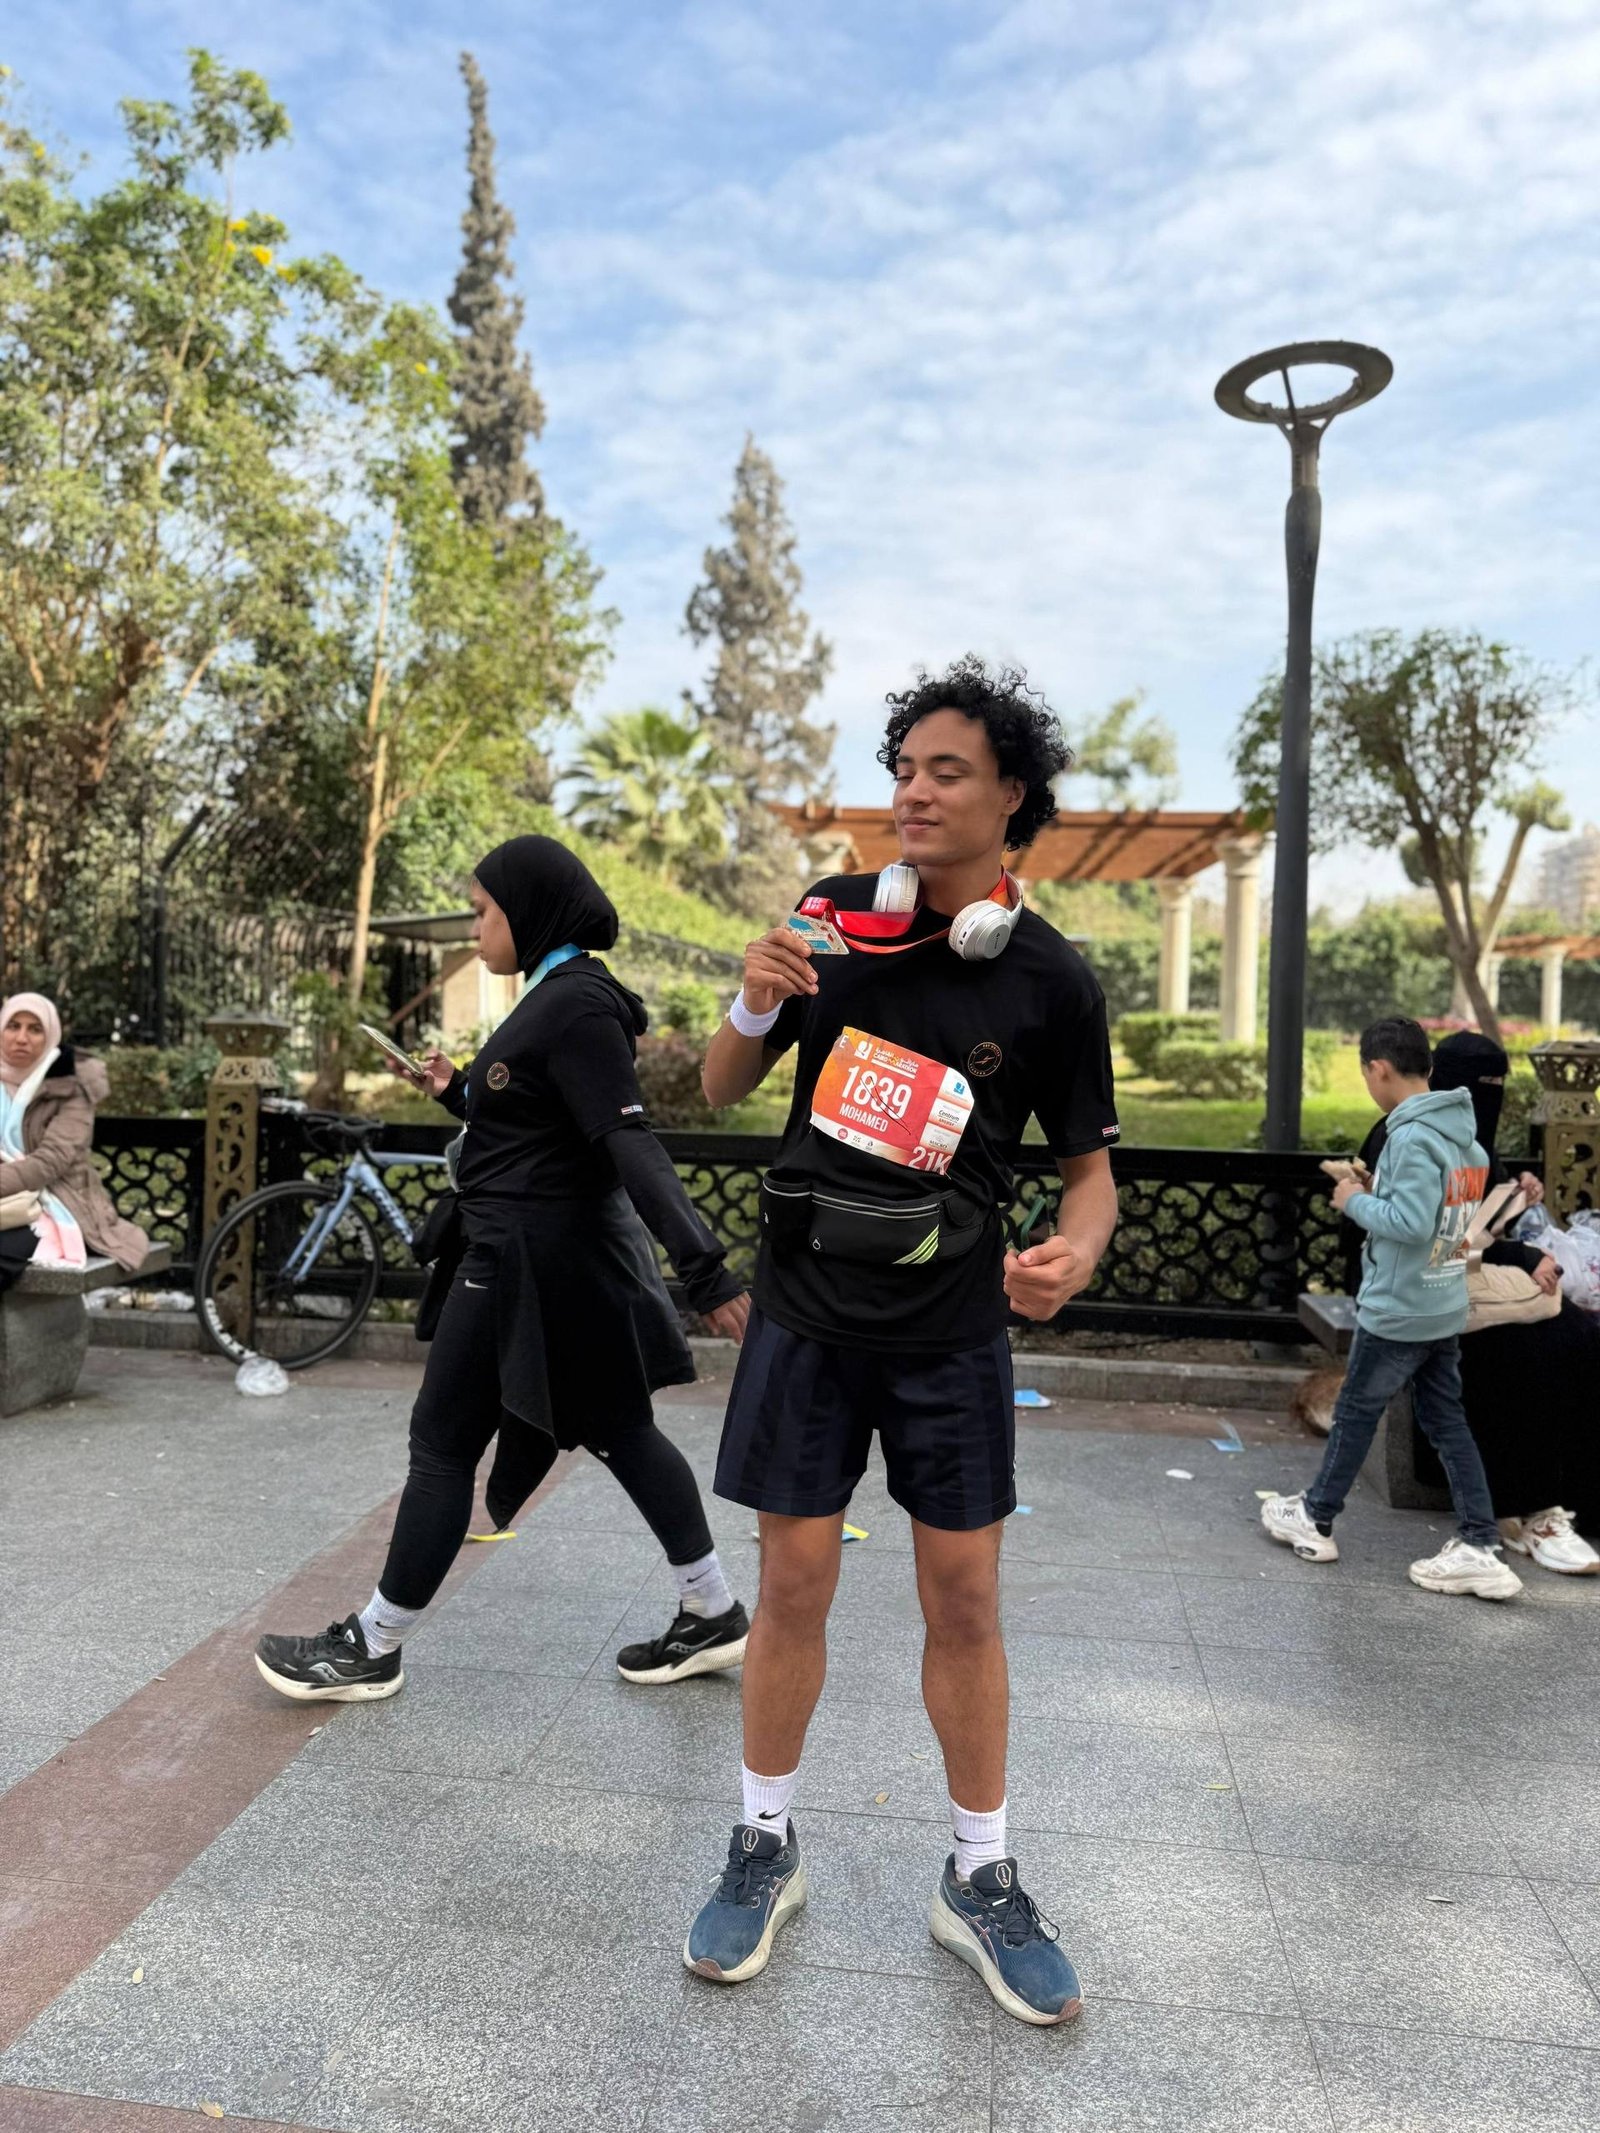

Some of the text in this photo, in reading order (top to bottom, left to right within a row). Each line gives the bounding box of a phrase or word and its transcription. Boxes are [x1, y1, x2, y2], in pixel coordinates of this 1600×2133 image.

[841, 1065, 912, 1119] 1839
[838, 1103, 888, 1132] MOHAMED
[938, 1109, 960, 1122] Centrum
[908, 1145, 952, 1176] 21K
